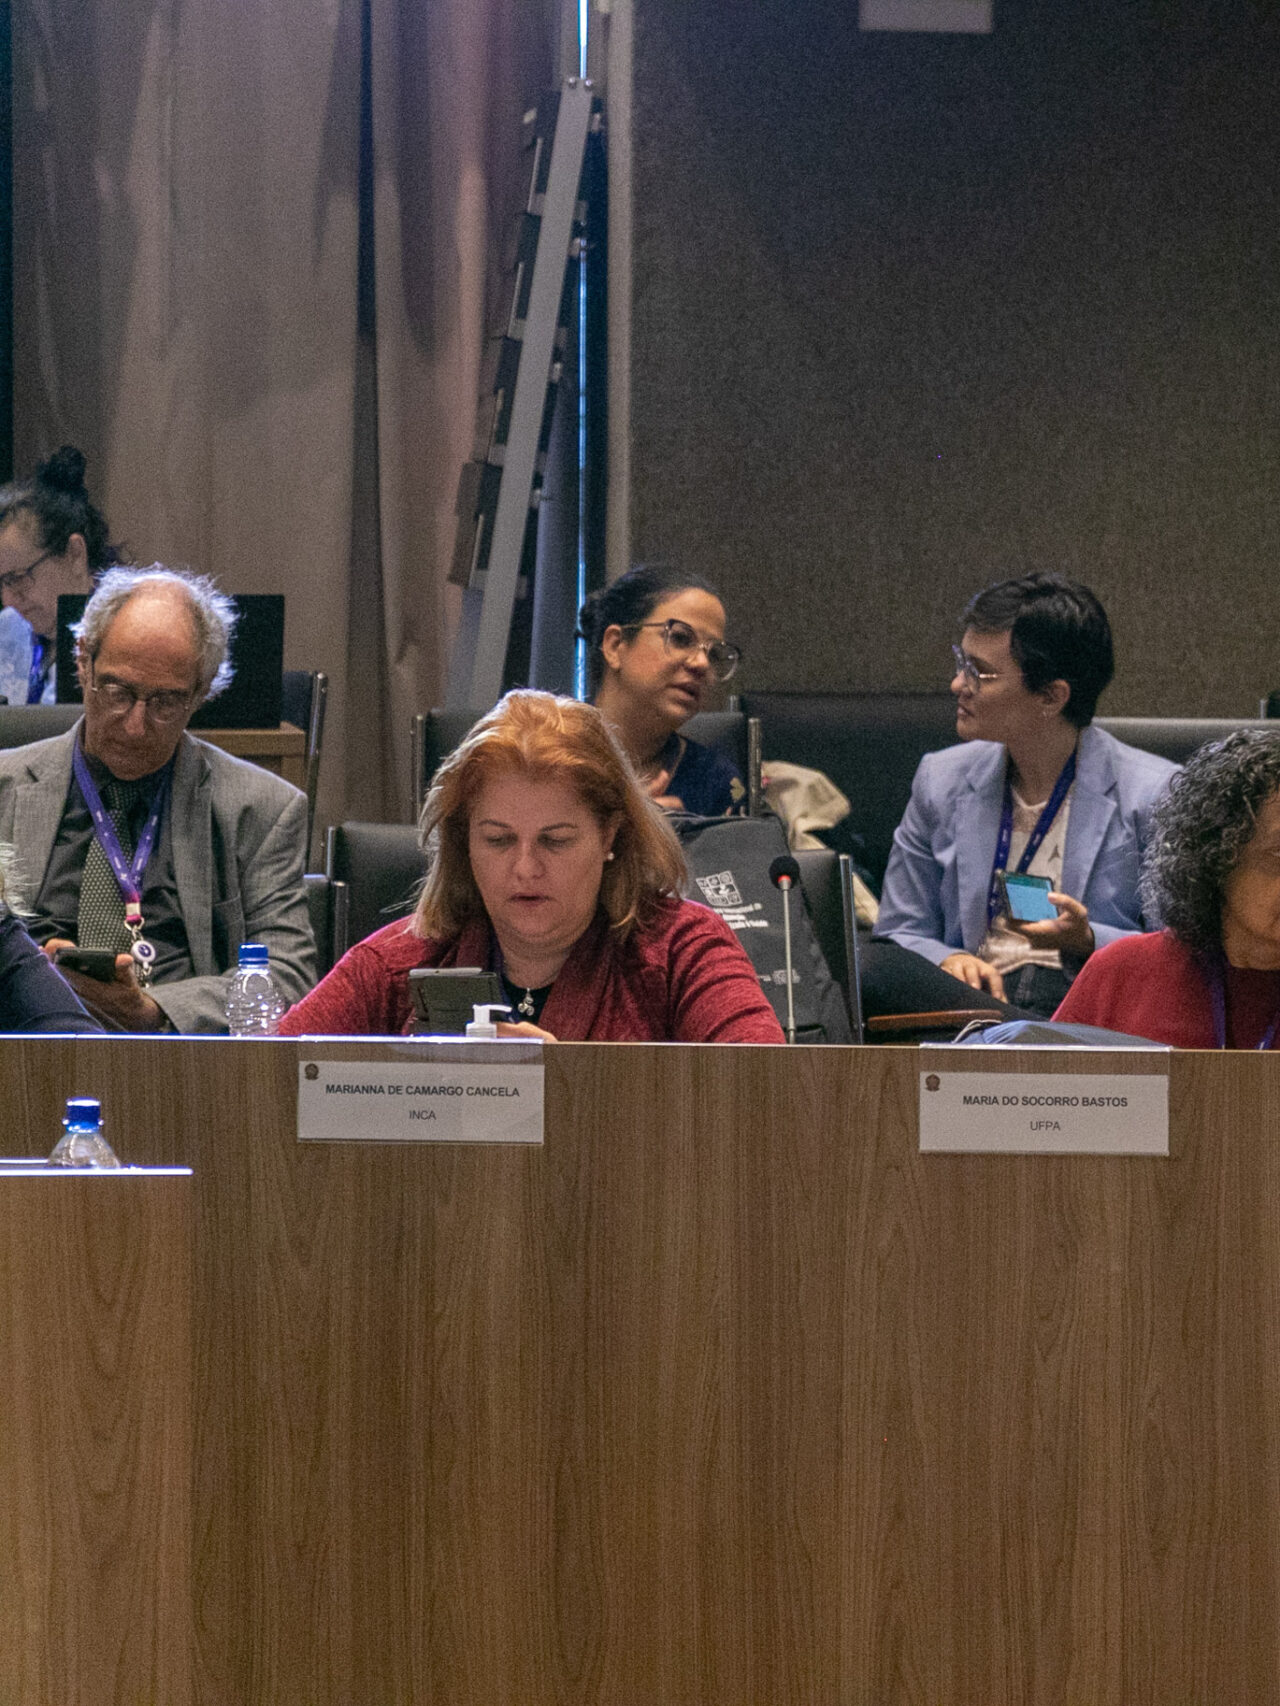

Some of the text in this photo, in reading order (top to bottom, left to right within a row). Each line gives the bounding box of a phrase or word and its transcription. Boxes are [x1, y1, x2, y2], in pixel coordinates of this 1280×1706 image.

[325, 1084, 520, 1097] MARIANNA DE CAMARGO CANCELA
[962, 1095, 1128, 1107] MARIA DO SOCORRO BASTOS
[409, 1110, 437, 1121] INCA
[1030, 1120, 1061, 1131] UFPA
